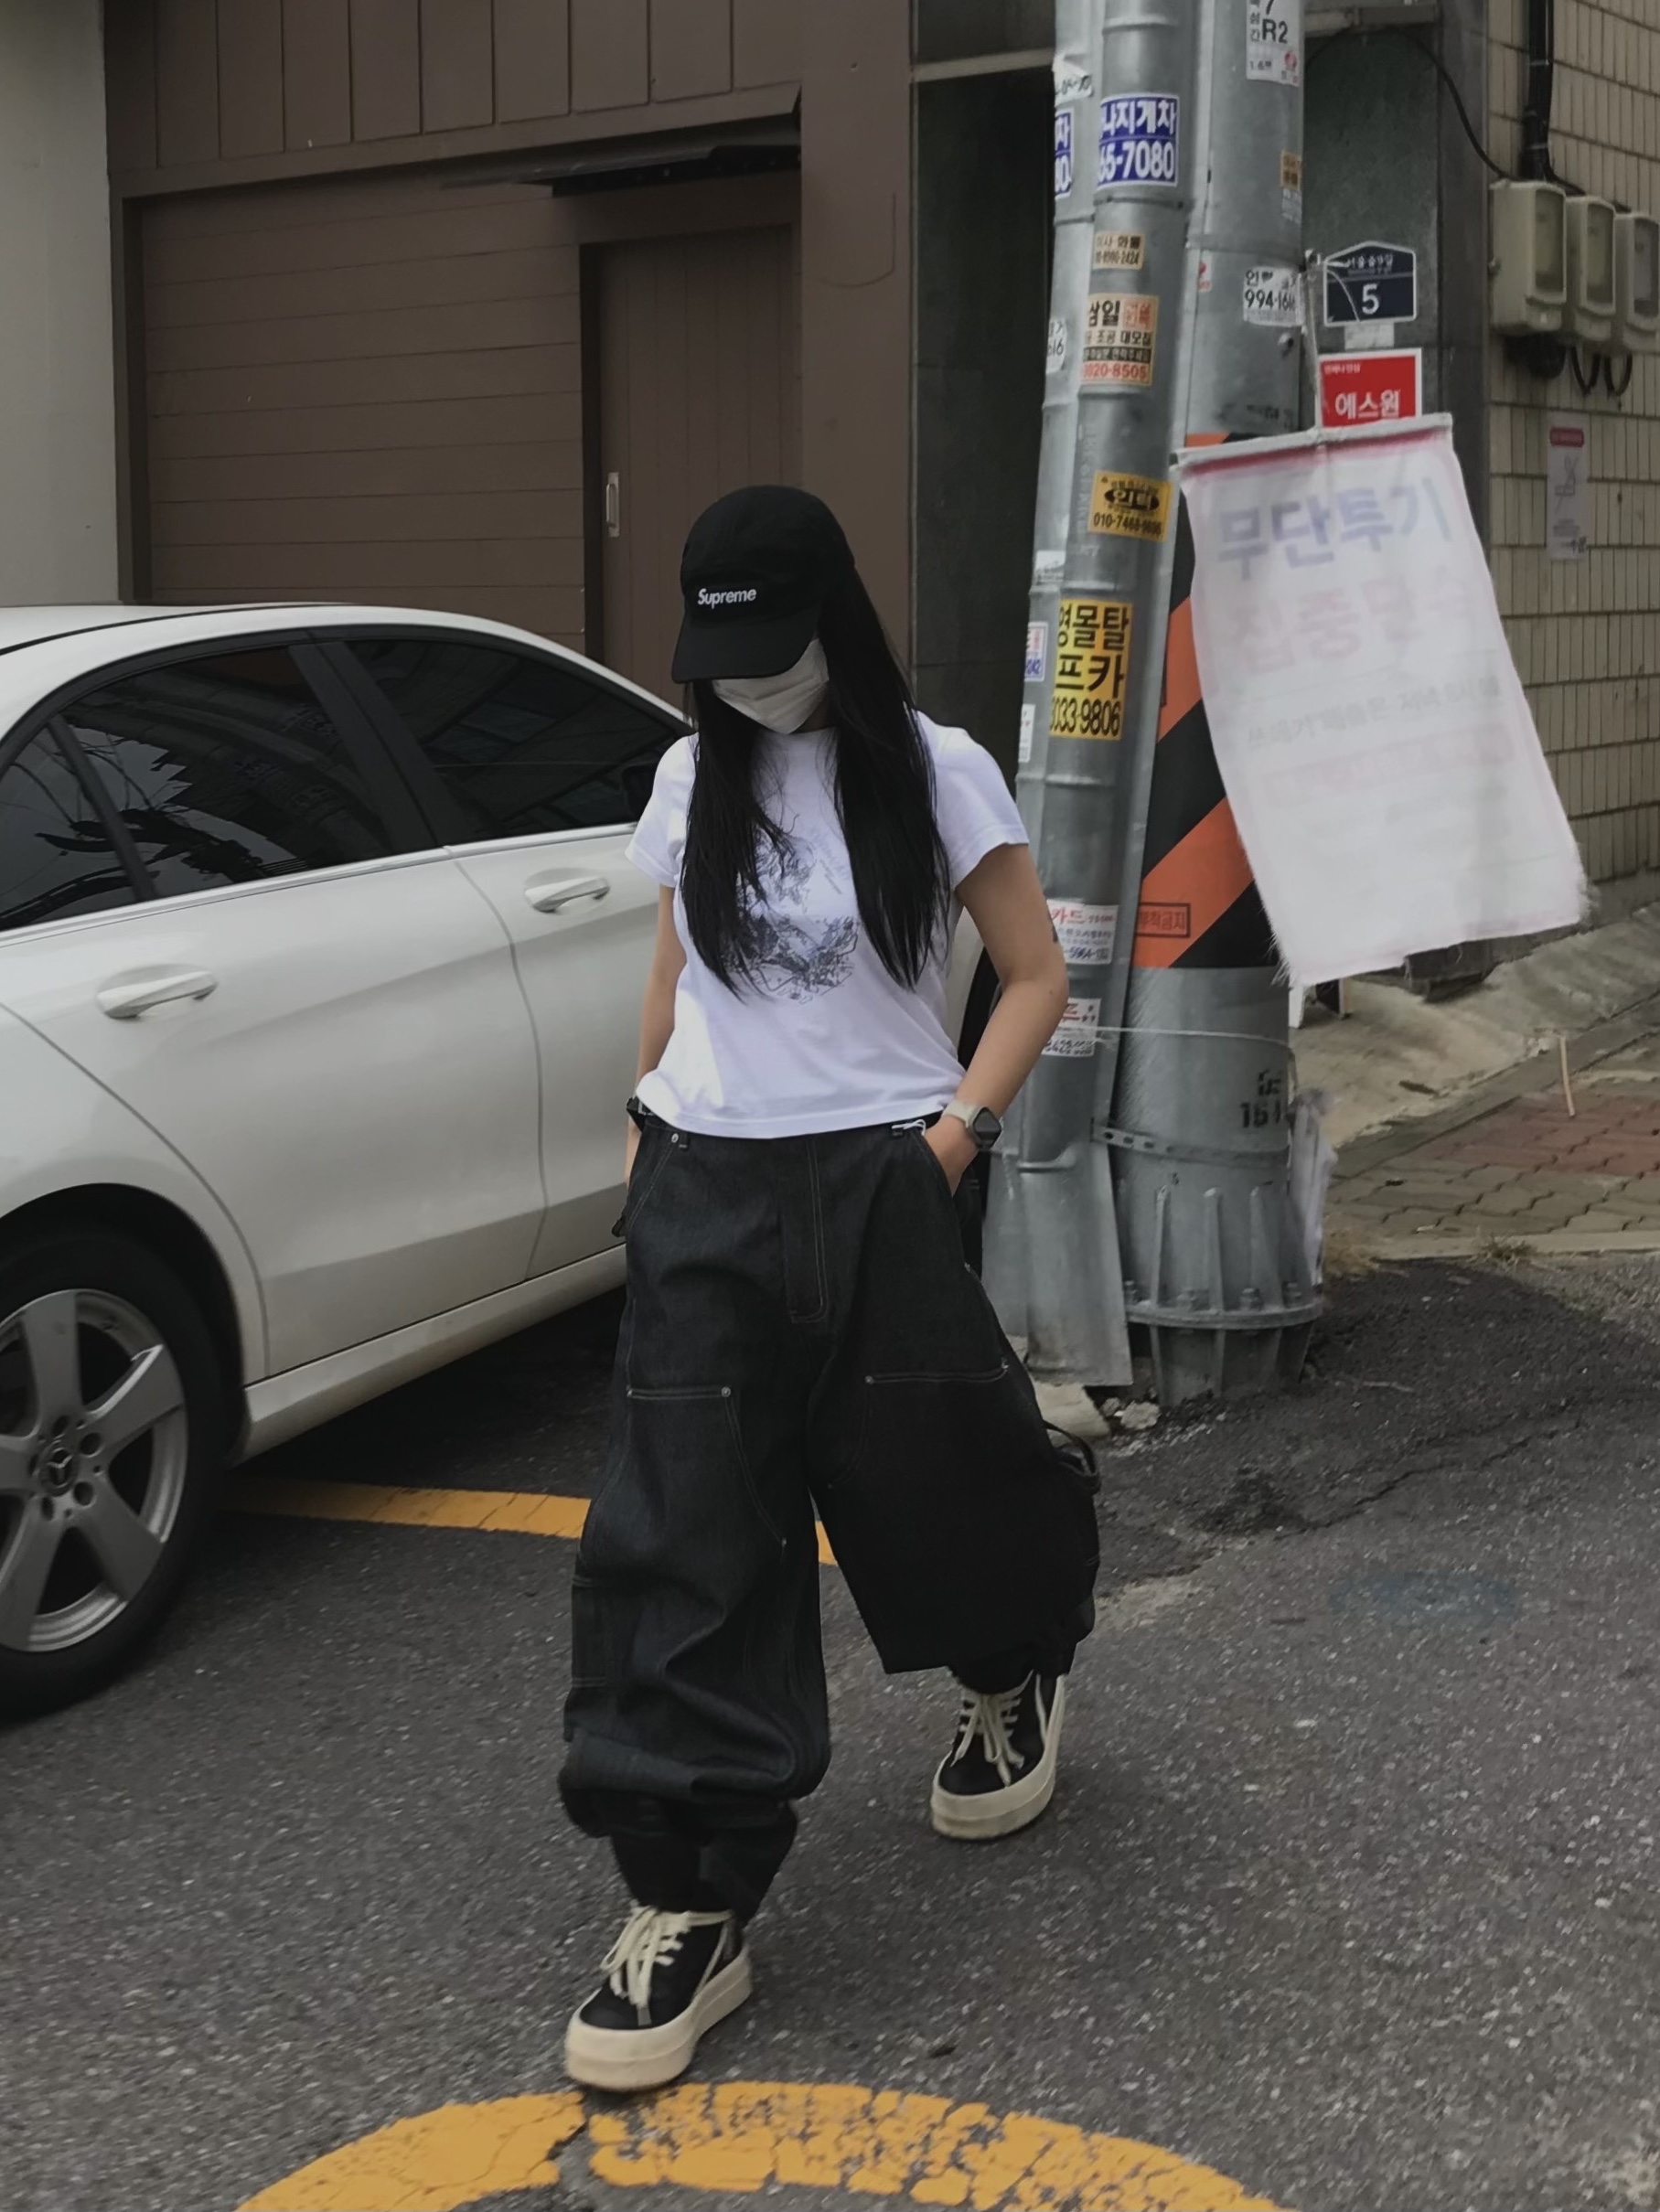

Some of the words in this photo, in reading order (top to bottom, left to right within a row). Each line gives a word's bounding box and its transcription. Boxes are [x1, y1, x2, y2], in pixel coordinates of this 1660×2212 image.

[1262, 18, 1288, 44] R2
[1361, 283, 1380, 315] 5
[1334, 389, 1400, 420] 에스원
[697, 588, 757, 610] Supreme
